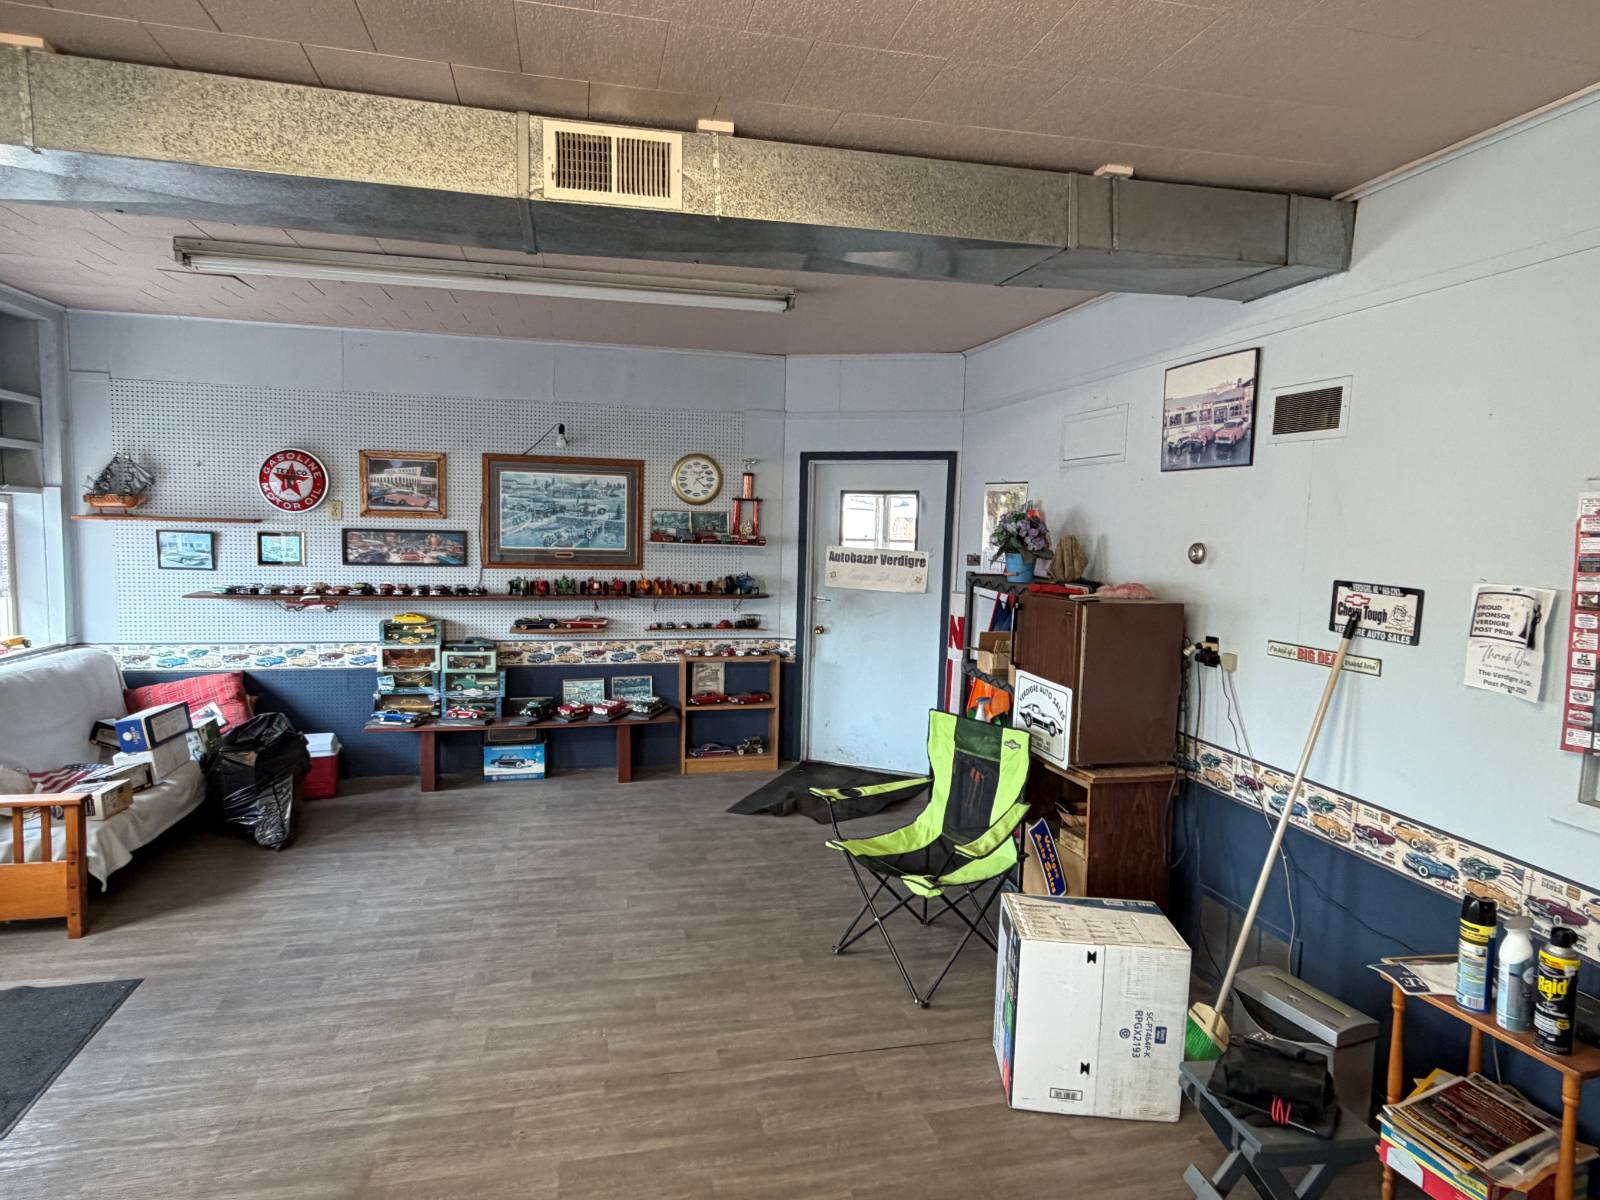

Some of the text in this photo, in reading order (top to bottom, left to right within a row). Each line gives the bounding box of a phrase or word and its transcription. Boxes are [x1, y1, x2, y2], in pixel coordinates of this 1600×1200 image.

[263, 452, 322, 479] GASOLINE
[276, 467, 308, 476] TEXCO
[261, 482, 322, 510] MOTOR OIL
[828, 551, 927, 569] Autobazar Verdigre
[1363, 605, 1388, 625] Tough
[1476, 612, 1511, 620] SPONSOR
[1475, 619, 1510, 628] VERDIGRE
[1366, 631, 1386, 641] AUTO
[1387, 634, 1411, 644] SALES
[1296, 647, 1315, 662] BIG
[1478, 668, 1491, 677] The
[1483, 679, 1499, 688] Post
[1020, 685, 1065, 721] VERDIGRE AUTO SALES
[1538, 975, 1569, 997] Raid
[1132, 1010, 1143, 1058] RPGX2193
